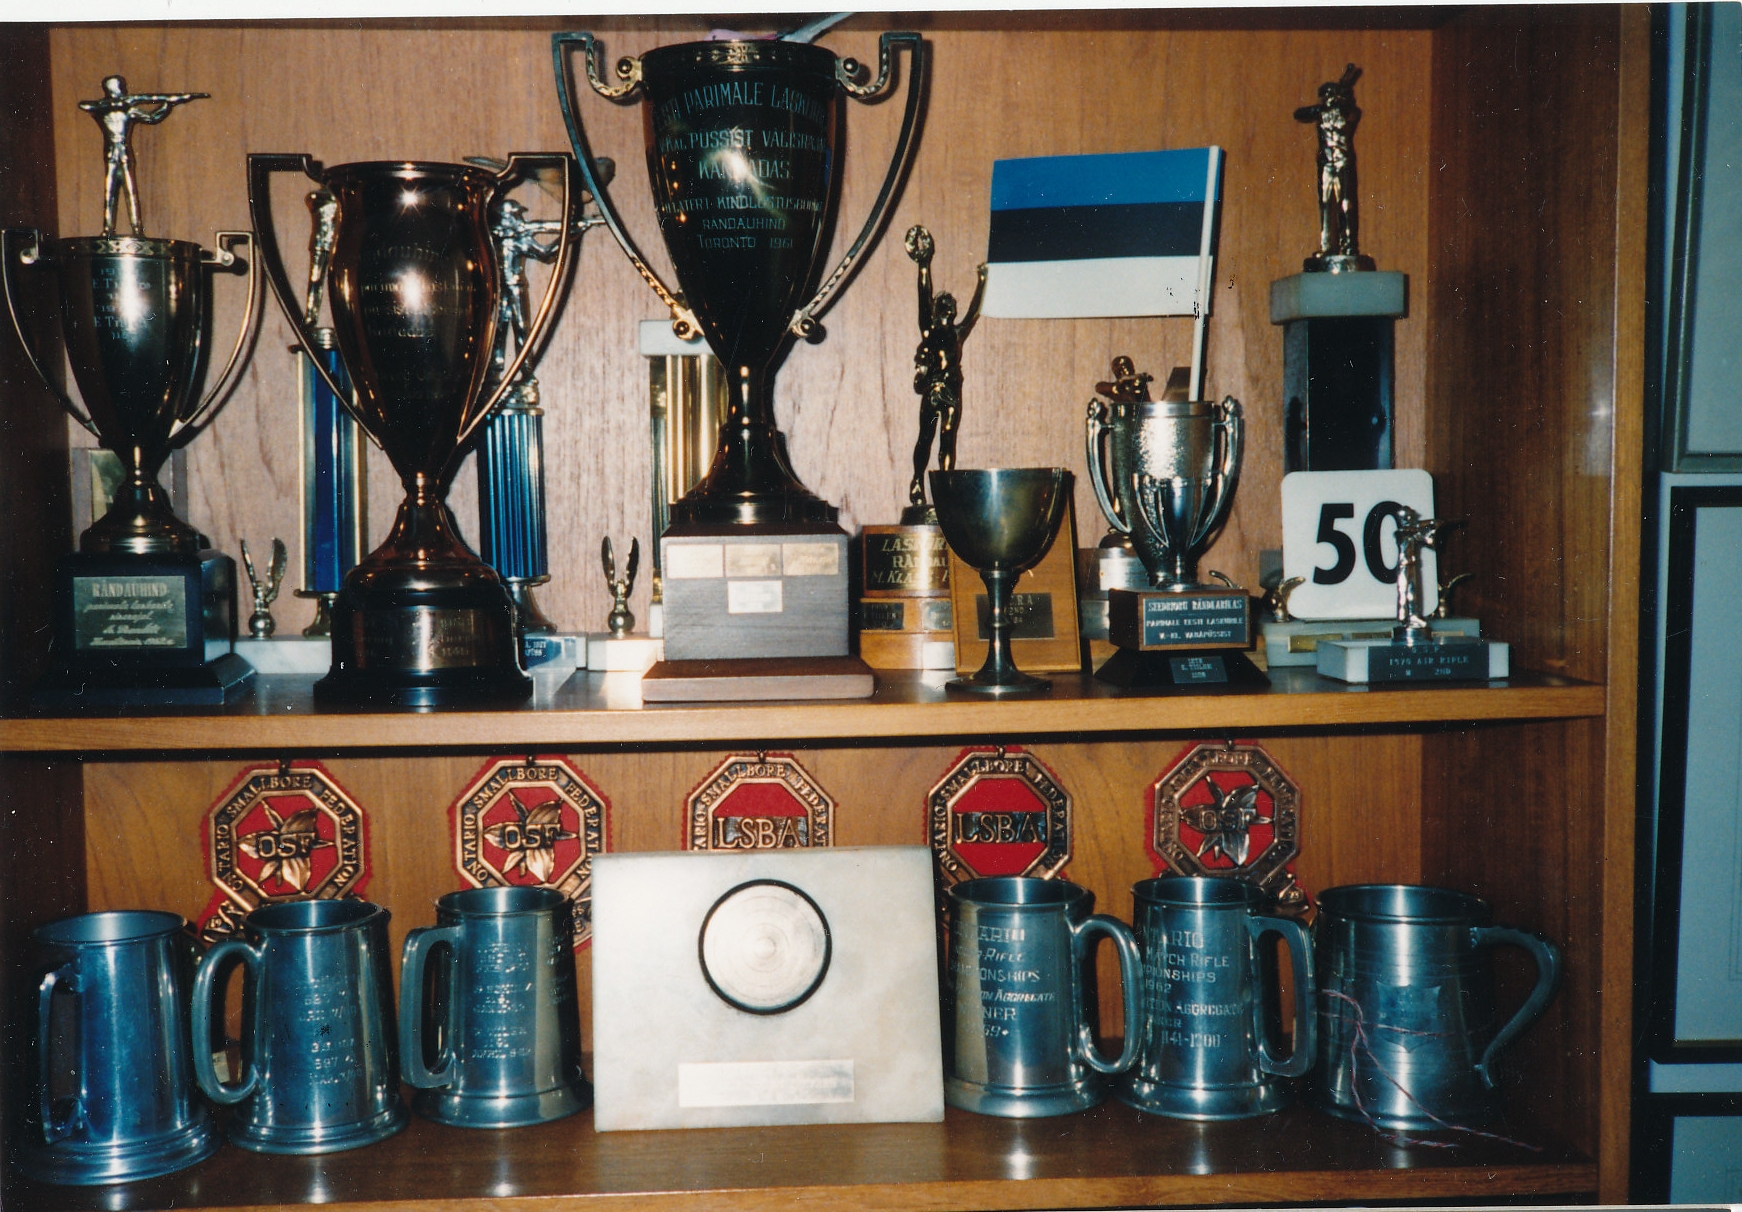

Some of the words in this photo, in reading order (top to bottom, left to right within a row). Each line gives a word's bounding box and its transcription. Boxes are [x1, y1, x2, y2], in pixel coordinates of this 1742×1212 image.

[684, 81, 764, 115] PARIMALE
[698, 234, 756, 249] TORONTO
[1312, 501, 1405, 585] 50
[1416, 657, 1434, 665] AIR
[1439, 656, 1469, 665] RIFLE
[473, 767, 558, 809] SMALLBORE
[940, 759, 1024, 801] SMALLBORE
[700, 763, 786, 806] SMALLBORE
[795, 778, 828, 847] FEDERAT
[227, 776, 312, 818] SMALLBORE
[320, 789, 357, 888] FEDERATION
[258, 832, 316, 858] OSF
[504, 823, 561, 849] OSF
[717, 817, 800, 849] LSBA
[955, 813, 1041, 845] LSBA
[464, 814, 489, 881] ONTARIO
[1190, 952, 1230, 968] RIFLE
